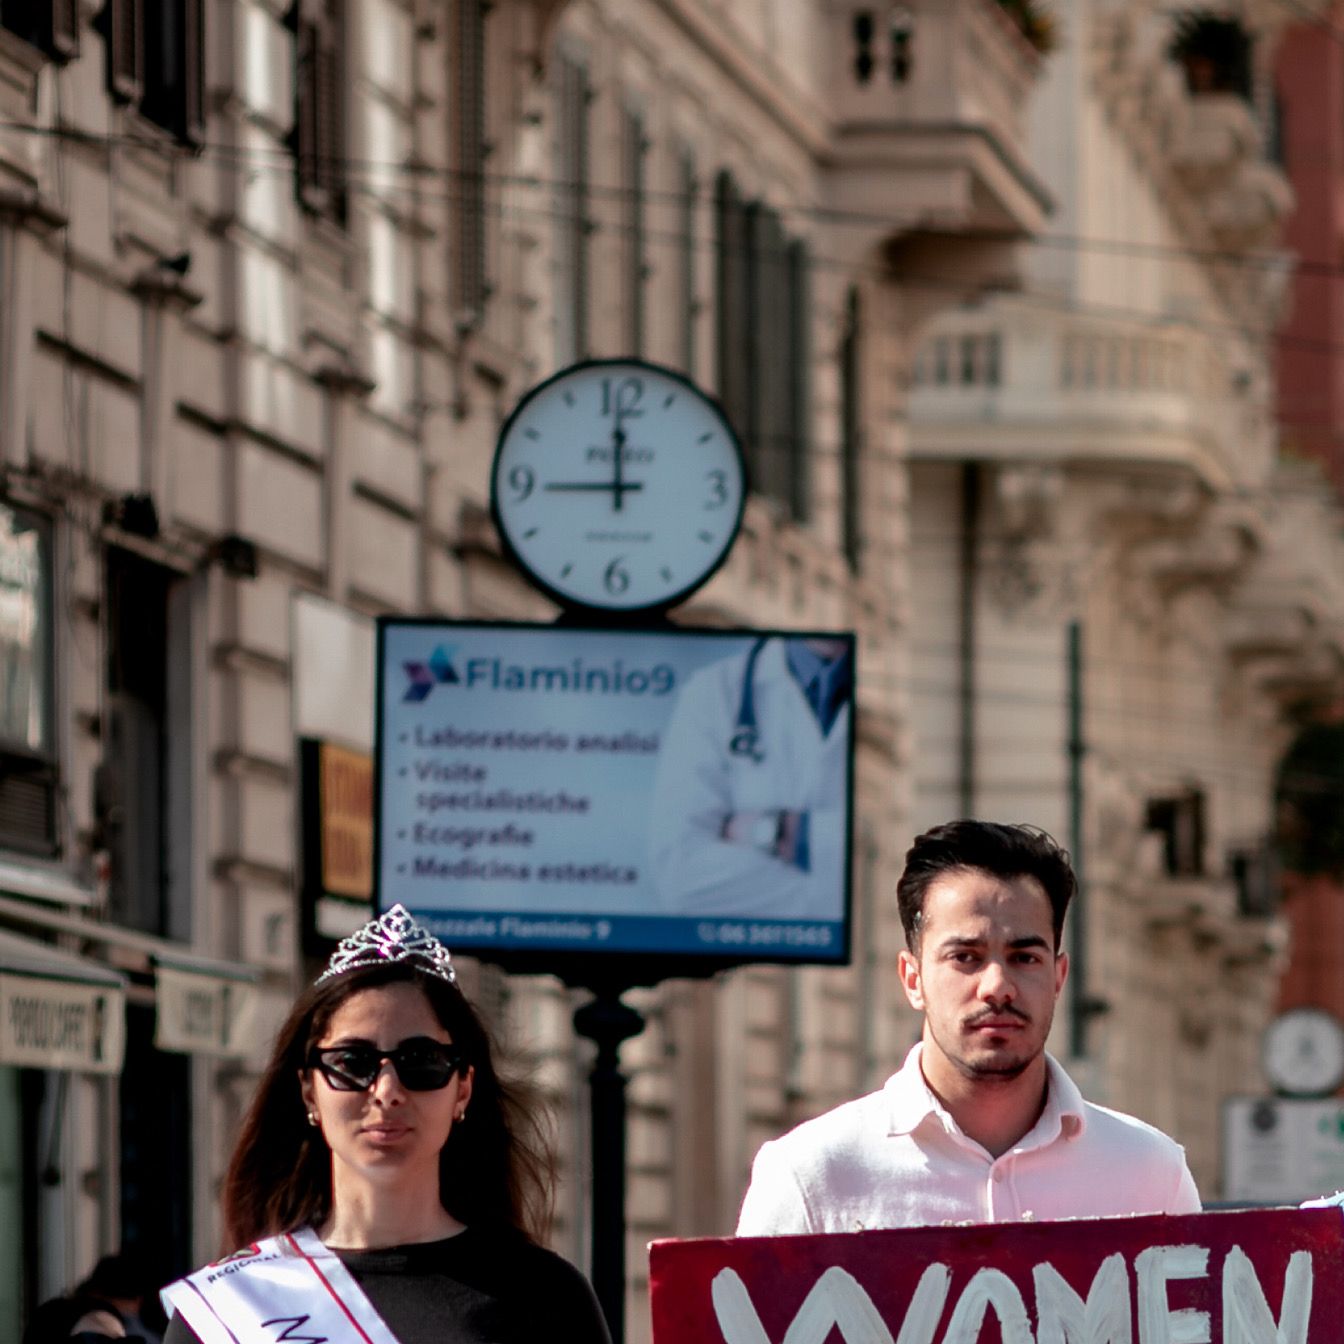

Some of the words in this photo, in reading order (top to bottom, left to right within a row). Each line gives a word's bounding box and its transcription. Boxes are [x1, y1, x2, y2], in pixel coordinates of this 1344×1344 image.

[508, 465, 535, 503] 9
[704, 468, 730, 511] 3
[603, 554, 631, 596] 6
[465, 657, 676, 698] Flaminio9
[415, 725, 569, 751] Laboratorio
[577, 730, 661, 756] analisi
[414, 760, 488, 783] Visite
[417, 787, 591, 814] specialistiche
[413, 822, 535, 852] Ecografie
[413, 857, 532, 882] Medicina
[537, 863, 640, 884] estetica
